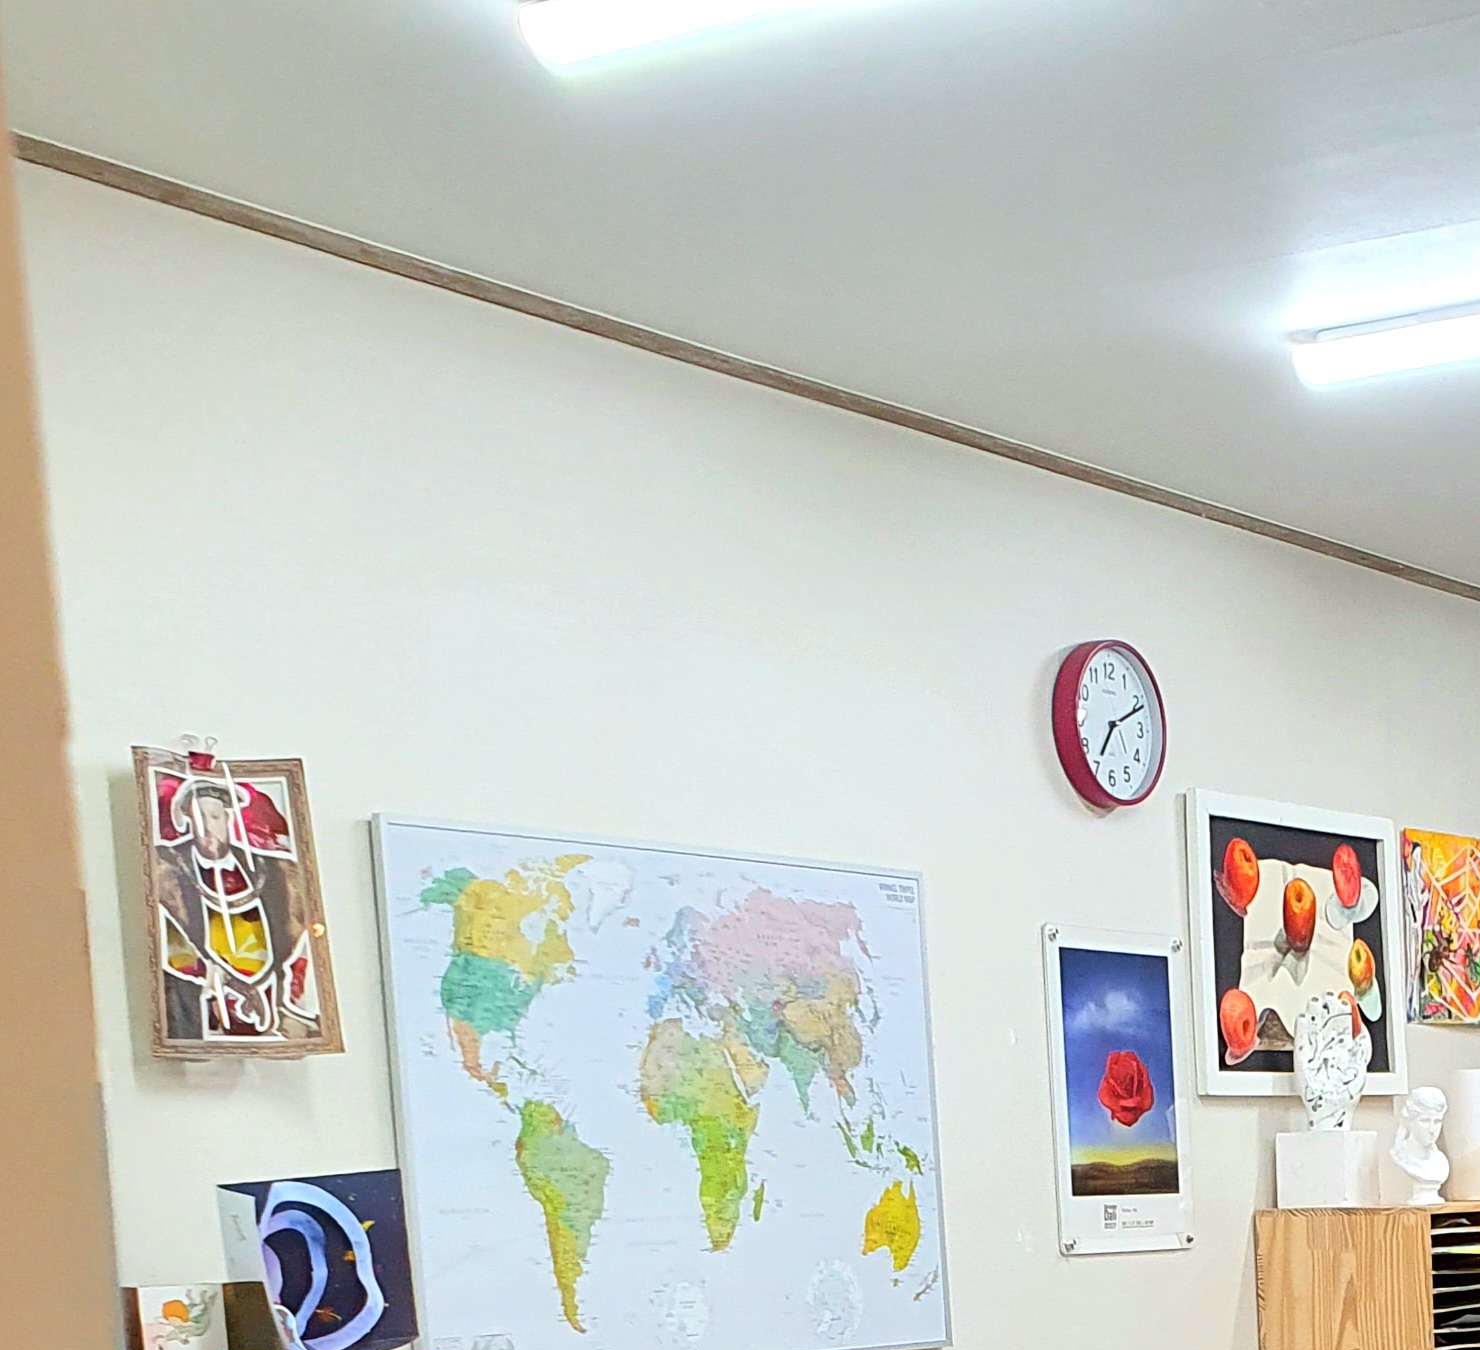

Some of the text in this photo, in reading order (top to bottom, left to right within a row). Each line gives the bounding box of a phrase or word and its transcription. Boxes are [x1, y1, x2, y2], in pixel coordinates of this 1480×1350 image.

[1089, 667, 1098, 684] 11
[1103, 662, 1115, 681] 12
[1122, 673, 1126, 690] 1
[1079, 684, 1089, 702] 0
[1133, 694, 1140, 711] 2
[1136, 722, 1144, 739] 3
[1133, 748, 1141, 764] 4
[1108, 769, 1116, 787] 6
[1123, 765, 1131, 783] 5
